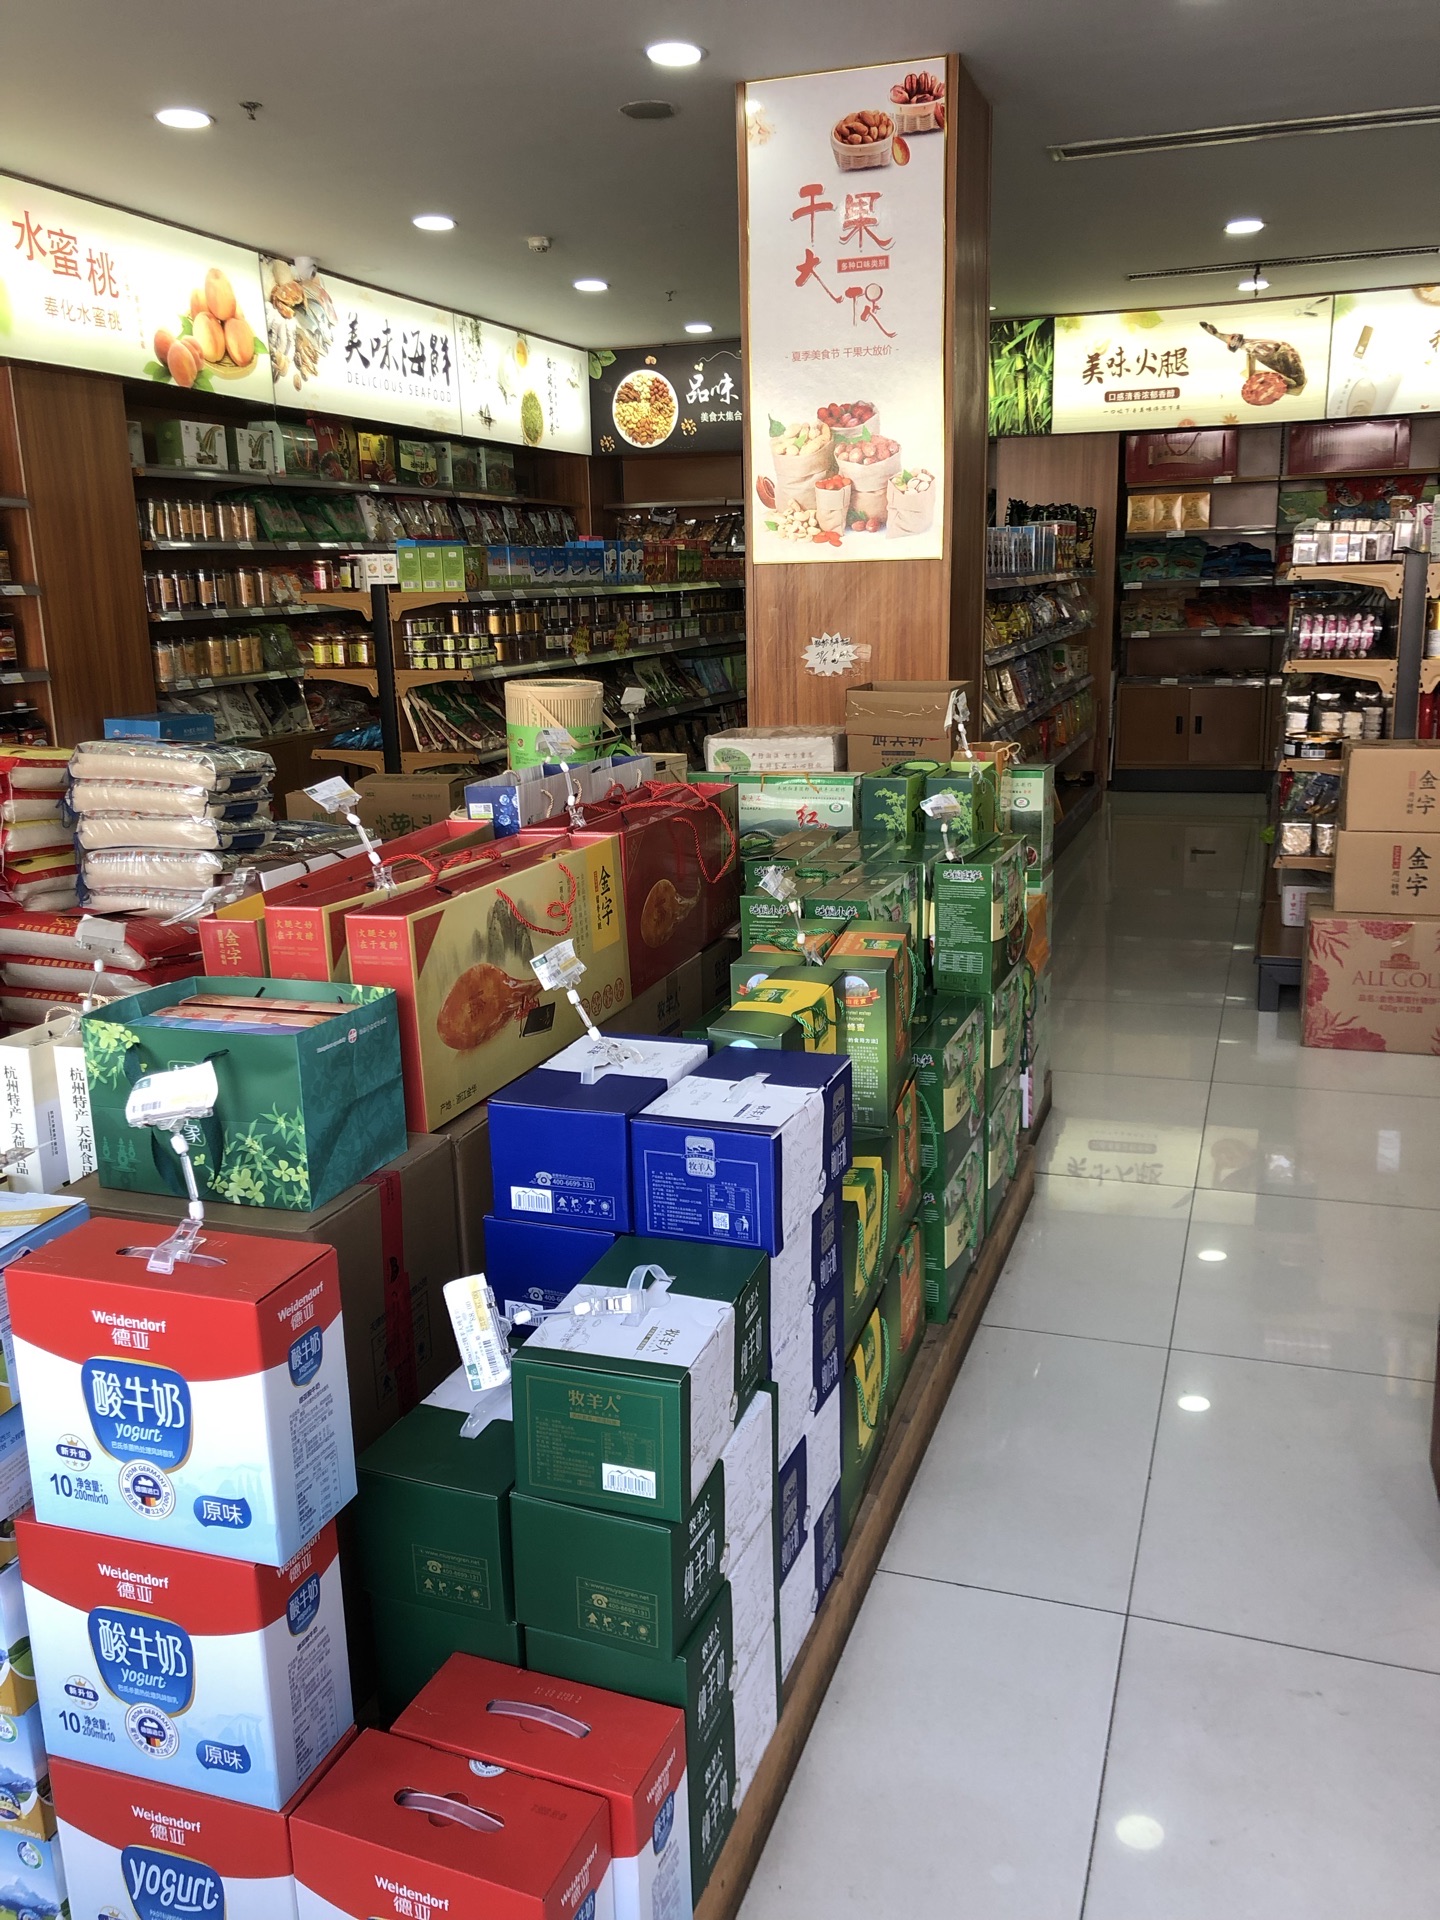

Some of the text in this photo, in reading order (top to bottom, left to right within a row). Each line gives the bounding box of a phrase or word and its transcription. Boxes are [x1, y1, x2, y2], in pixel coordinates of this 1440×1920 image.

[12, 210, 119, 298] 水蜜桃
[841, 259, 886, 271] 多种口味类别
[45, 296, 122, 331] 奉化水蜜桃
[791, 344, 892, 362] 夏季美食节 干果大放价
[1082, 346, 1190, 385] 美味火腿
[347, 371, 451, 402] DELICIOUS SEAFOOD
[686, 372, 739, 405] 品味
[701, 410, 743, 423] 美食大集合
[1416, 770, 1440, 815] 金字
[1406, 847, 1432, 897] 金字
[599, 866, 613, 926] 金字
[276, 920, 313, 929] 火腿之妙
[277, 931, 315, 941] 在于发酵
[359, 929, 398, 939] 火腿之妙
[224, 929, 242, 966] 金字
[360, 940, 399, 951] 在于发酵
[1352, 971, 1388, 987] ALL
[69, 1067, 89, 1122] 杭州特产
[4, 1065, 29, 1175] 杭州特产 天荷品
[688, 1161, 714, 1173] 牧羊人
[552, 1179, 594, 1189] 400-6699-131
[277, 1281, 324, 1323] Weidendorf
[91, 1310, 167, 1334] Weidendorf
[291, 1301, 315, 1332] 德亚
[112, 1327, 151, 1351] 德亚
[291, 1331, 321, 1372] 酸牛奶
[652, 1328, 681, 1353] 牧羊人
[92, 1369, 185, 1429] 酸牛奶
[569, 1390, 618, 1413] 牧羊人
[115, 1422, 162, 1443] yogurt
[60, 1446, 88, 1460] 新升级
[50, 1473, 73, 1498] 10
[75, 1477, 104, 1493] 净含量:
[125, 1464, 168, 1489] FROM GERMANY
[134, 1485, 160, 1497] 德国进口
[202, 1500, 244, 1526] 原味
[688, 1500, 710, 1536] 牧羊人
[98, 1562, 169, 1590] Weidendorf
[288, 1550, 313, 1584] 德亚
[684, 1529, 716, 1606] 纯羊奶
[116, 1581, 154, 1604] 德亚
[289, 1578, 319, 1621] 酸牛奶
[98, 1617, 188, 1678] 酸牛奶
[121, 1667, 167, 1690] yogurt
[698, 1649, 725, 1730] 纯羊奶
[68, 1685, 96, 1700] 新升级
[59, 1710, 81, 1733] 10
[84, 1714, 111, 1731] 净含量:
[131, 1707, 171, 1731] FROM GERMANY
[204, 1745, 244, 1771] 原味
[646, 1748, 676, 1804] Weidendorf
[131, 1804, 201, 1834] Weidendorf
[702, 1769, 729, 1855] 纯羊奶
[150, 1823, 187, 1847] 德亚
[129, 1858, 219, 1911] yogurt
[560, 1843, 598, 1908] Weidendorf
[374, 1874, 450, 1914] Weidendorf
[393, 1895, 432, 1920] 德亚
